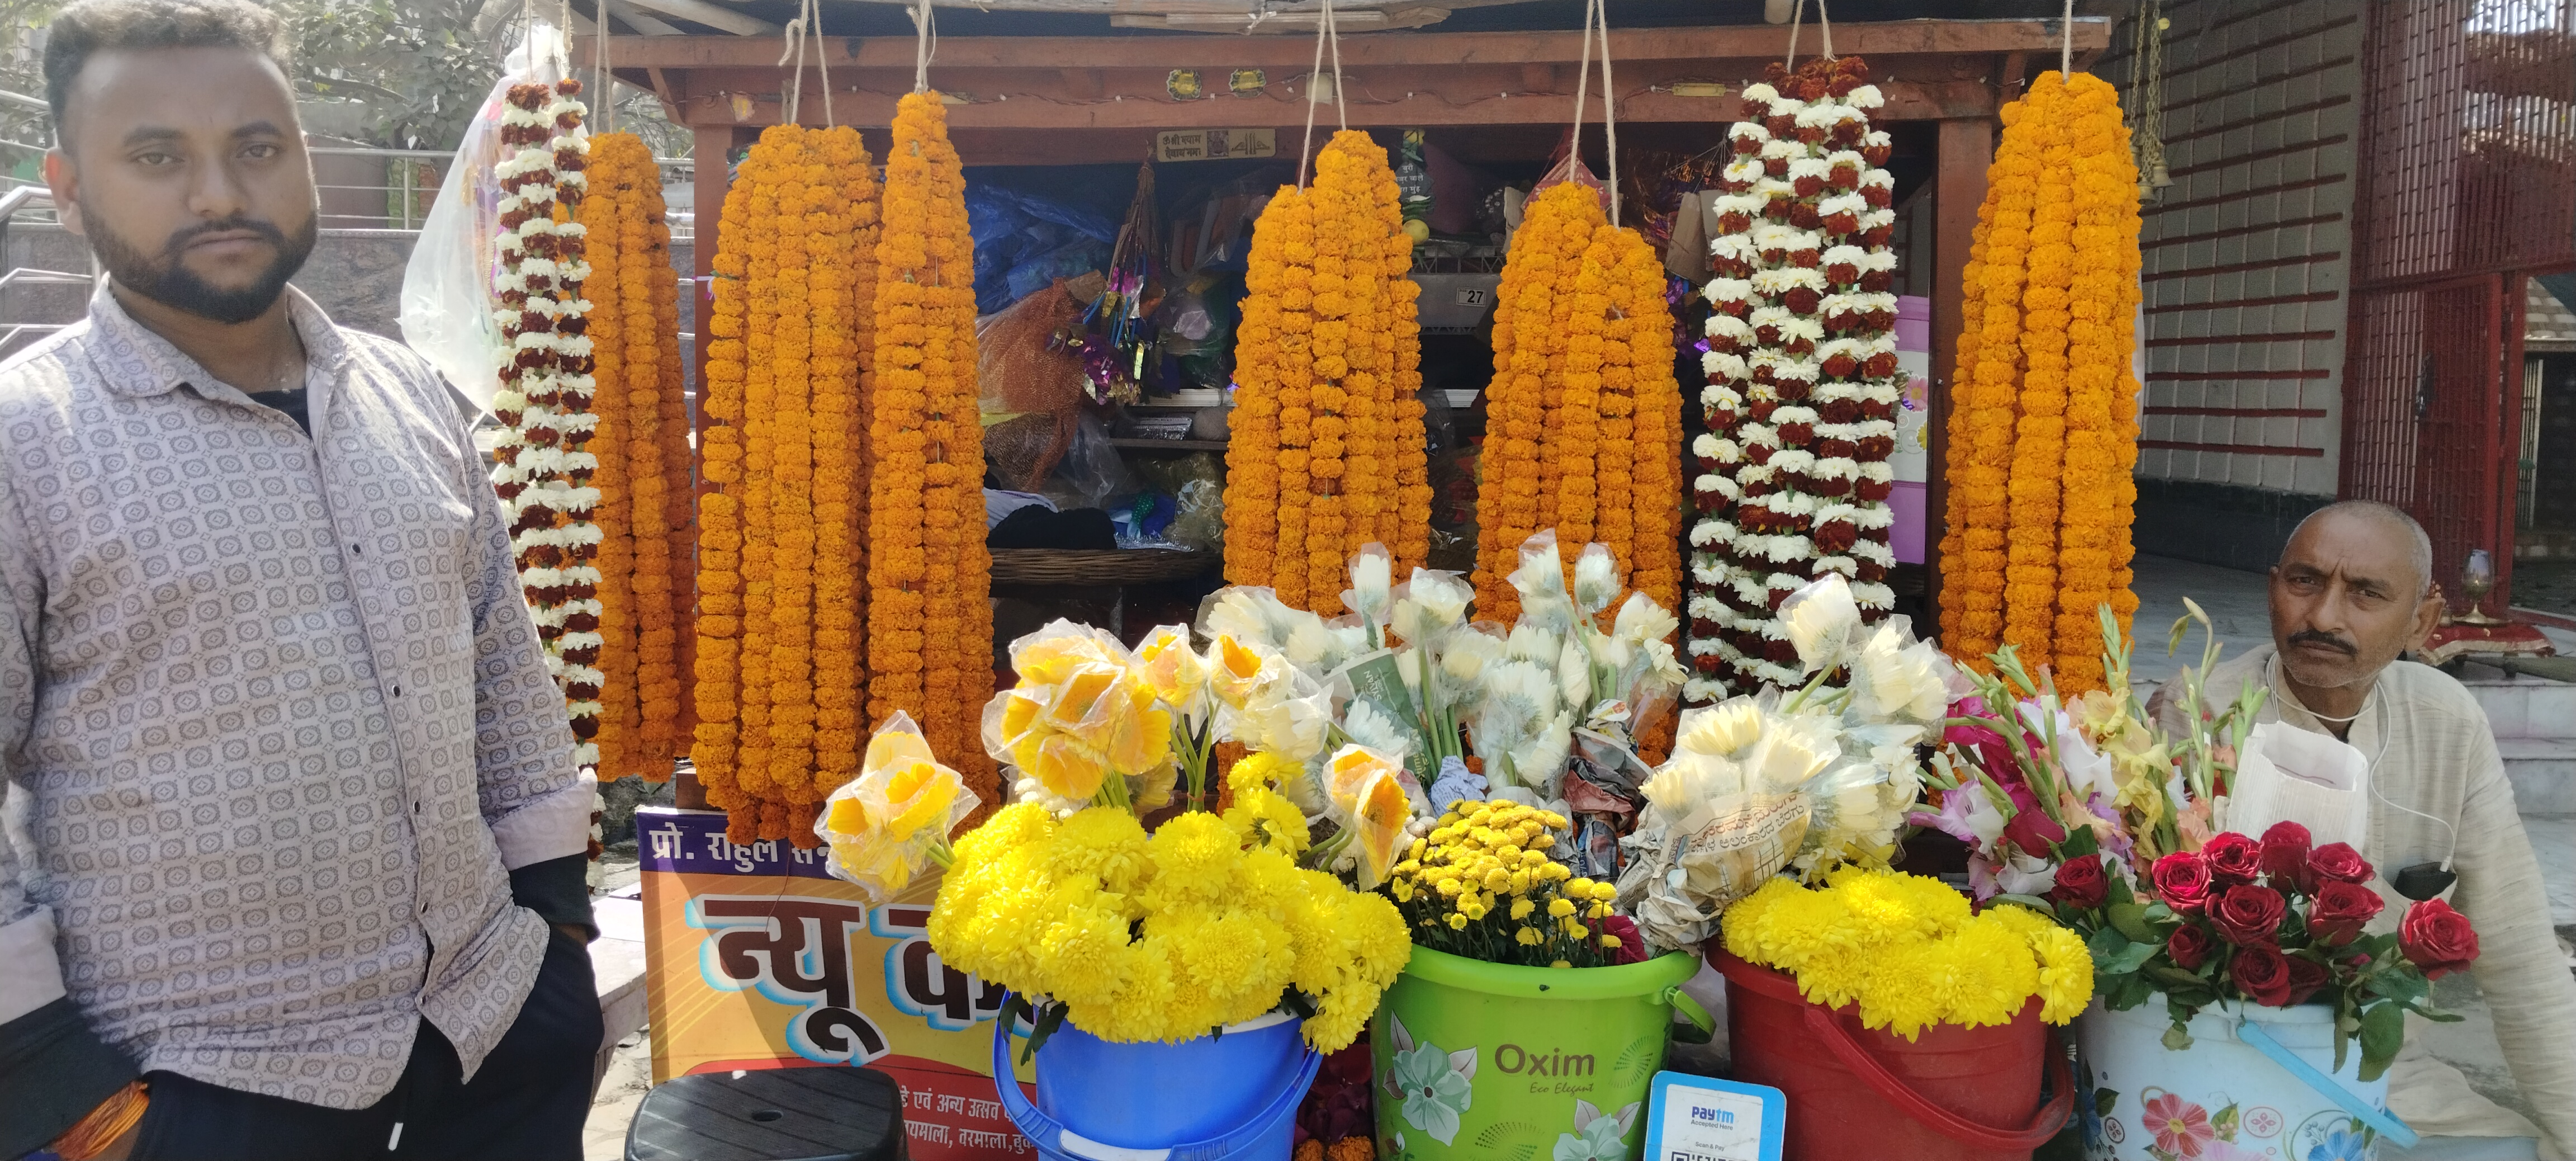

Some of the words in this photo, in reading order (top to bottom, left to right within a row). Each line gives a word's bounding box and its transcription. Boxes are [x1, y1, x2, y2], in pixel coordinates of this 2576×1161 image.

[1467, 290, 1484, 303] 27
[1363, 671, 1382, 701] SYLVAN
[649, 822, 694, 859] प्रो.
[705, 833, 778, 872] राहुल
[693, 897, 890, 1058] न्यू
[1495, 1044, 1595, 1077] Oxim
[913, 1088, 933, 1110] एवं
[937, 1094, 965, 1115] अन्य
[969, 1098, 1001, 1120] उत्सव
[1530, 1082, 1549, 1093] Eco
[1554, 1082, 1594, 1097] Elegant
[1691, 1119, 1718, 1129] Accepted
